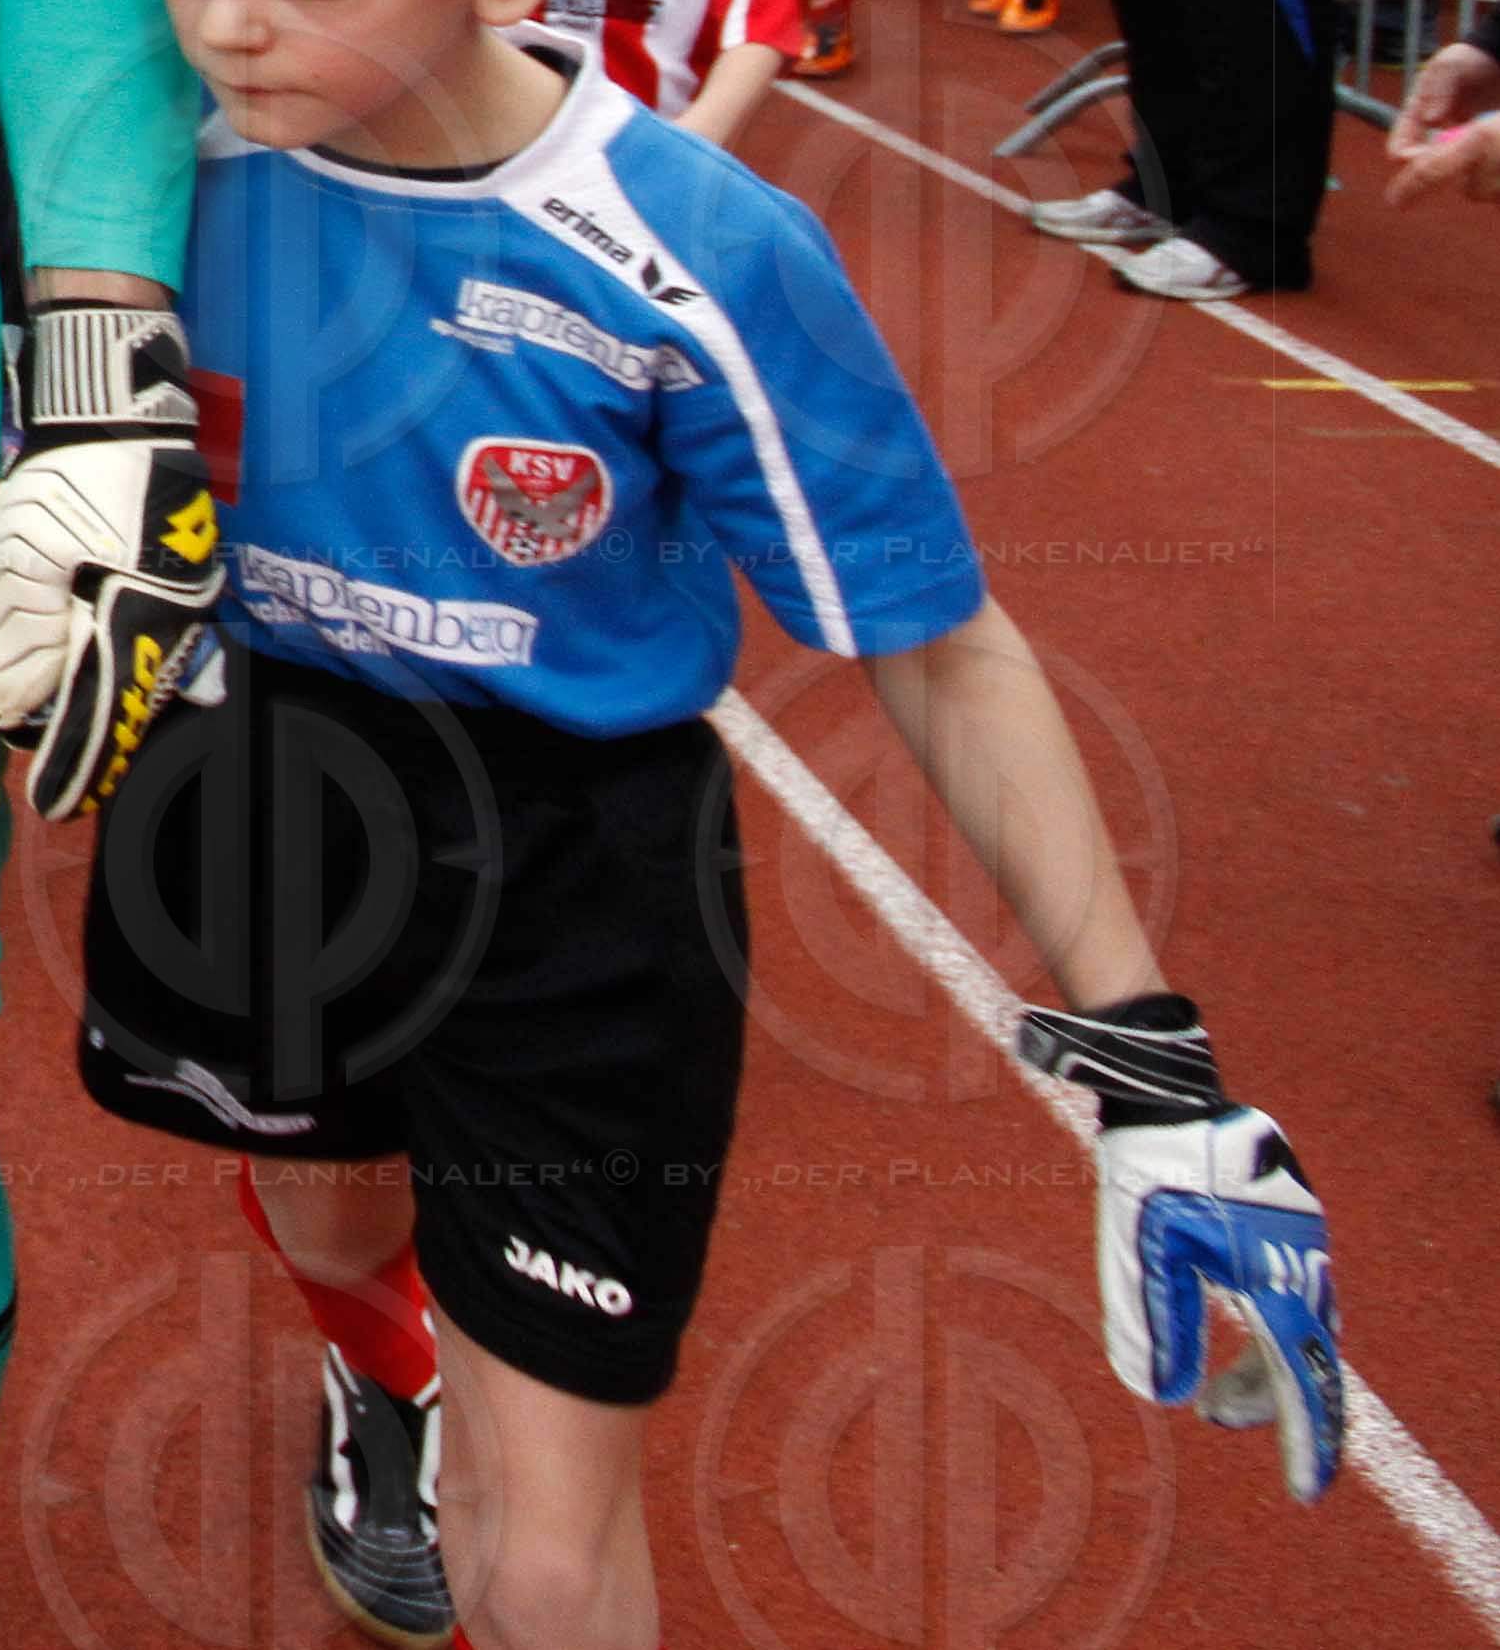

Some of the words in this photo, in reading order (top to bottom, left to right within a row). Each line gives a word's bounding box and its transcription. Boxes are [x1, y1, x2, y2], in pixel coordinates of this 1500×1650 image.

[542, 197, 635, 265] erima
[509, 449, 577, 481] KSV
[503, 1234, 634, 1318] JAKO
